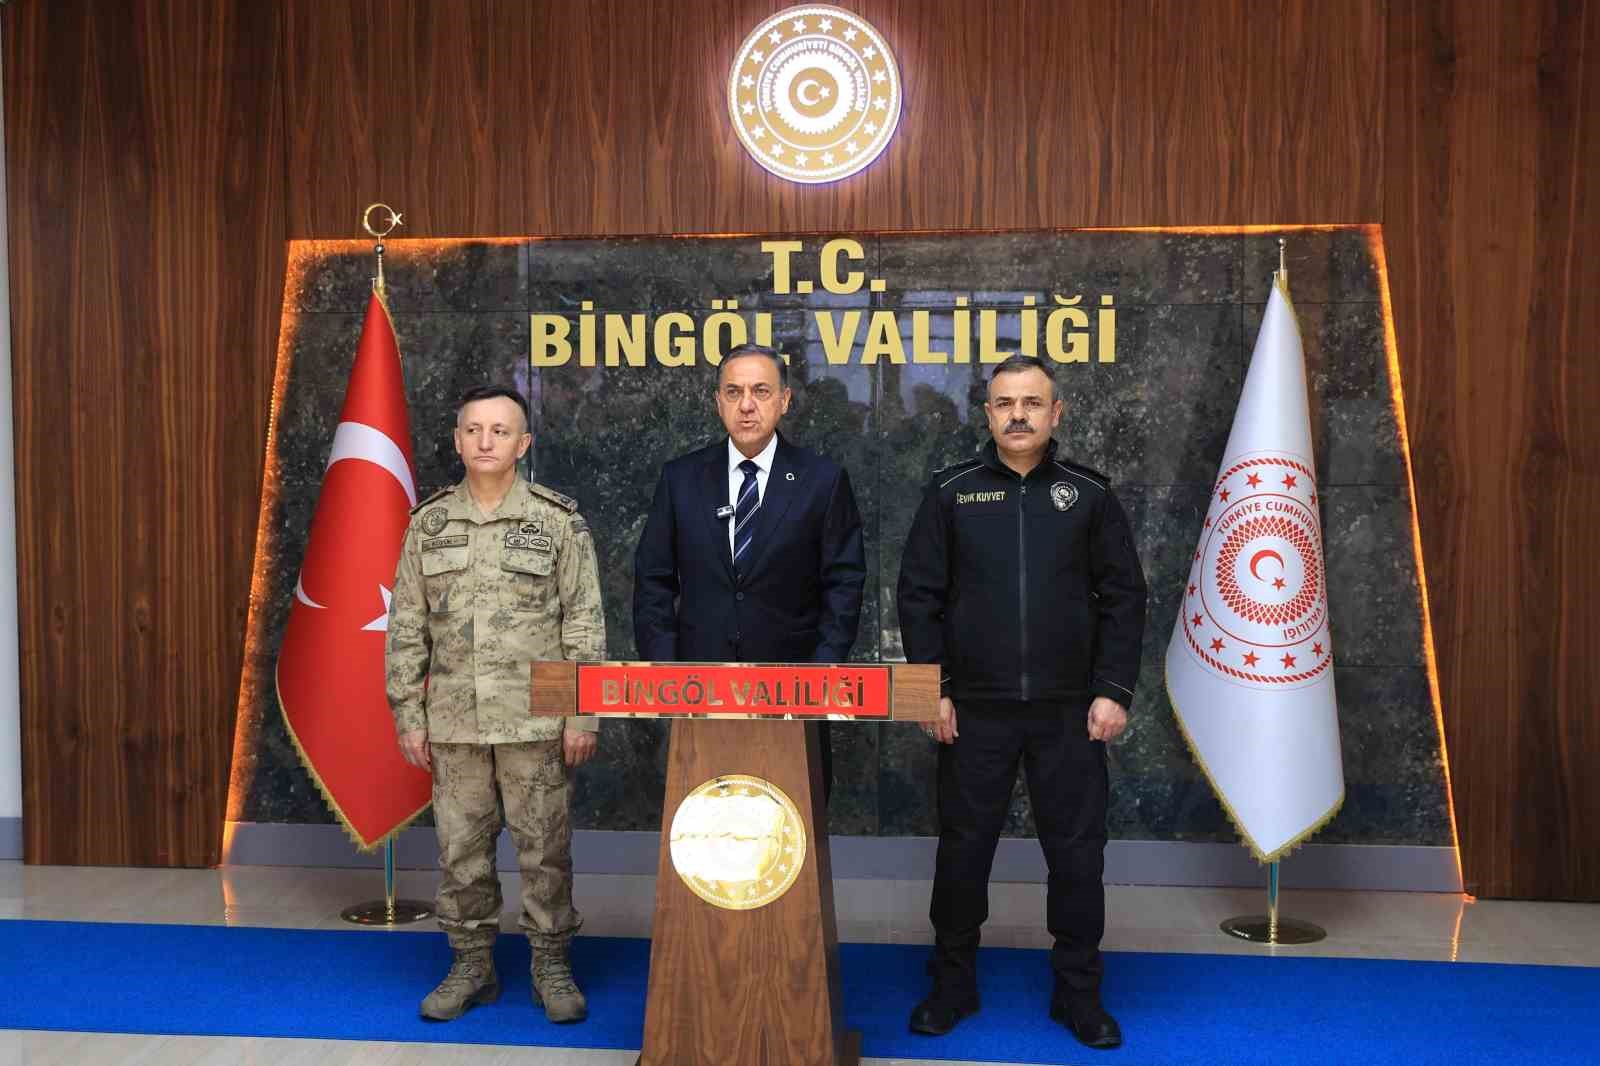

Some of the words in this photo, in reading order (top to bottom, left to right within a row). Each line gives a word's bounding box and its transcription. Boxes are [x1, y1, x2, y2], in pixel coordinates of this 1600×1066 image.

[761, 238, 886, 294] T.C.
[530, 299, 790, 367] BİNGÖL
[814, 294, 1116, 364] VALİLİĞİ
[602, 673, 723, 706] BİNGÖL
[730, 676, 864, 707] VALİLİĞİ
